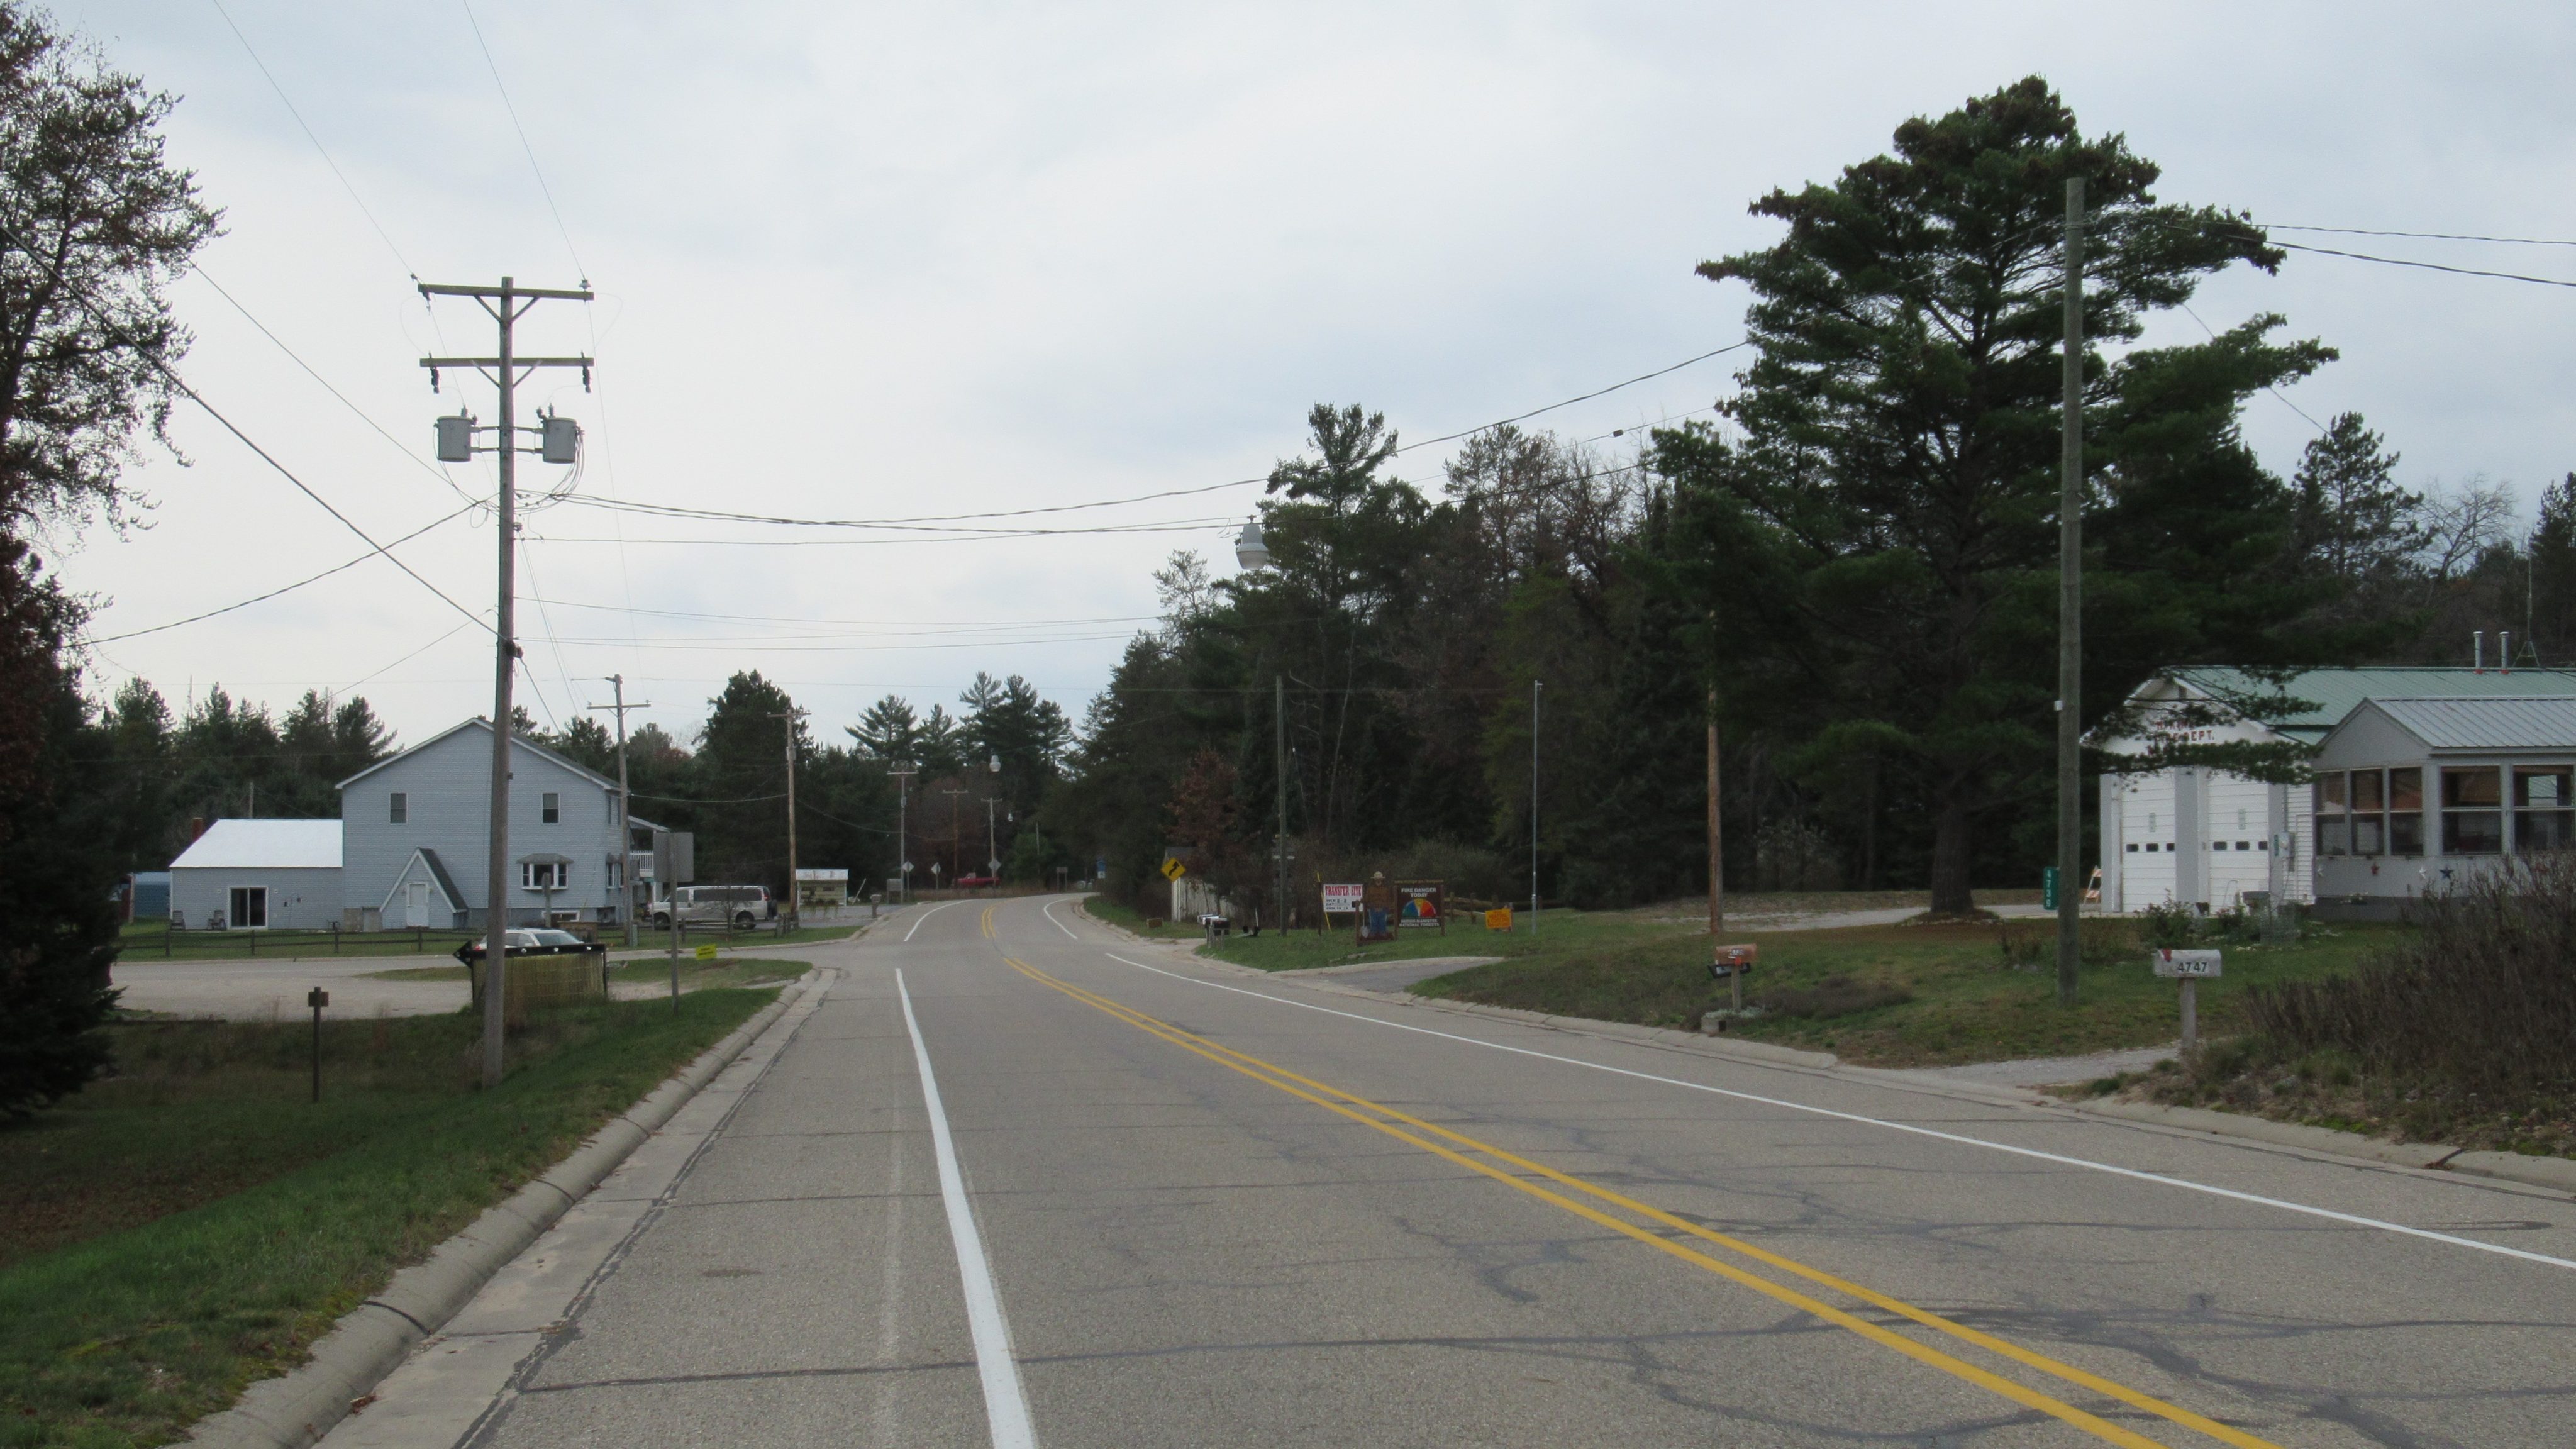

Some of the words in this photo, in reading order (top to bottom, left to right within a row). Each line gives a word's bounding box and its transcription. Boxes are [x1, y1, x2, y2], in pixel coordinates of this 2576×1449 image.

[1325, 886, 1348, 896] TRANSFER
[1352, 886, 1362, 896] SITE
[2177, 962, 2207, 972] 4747
